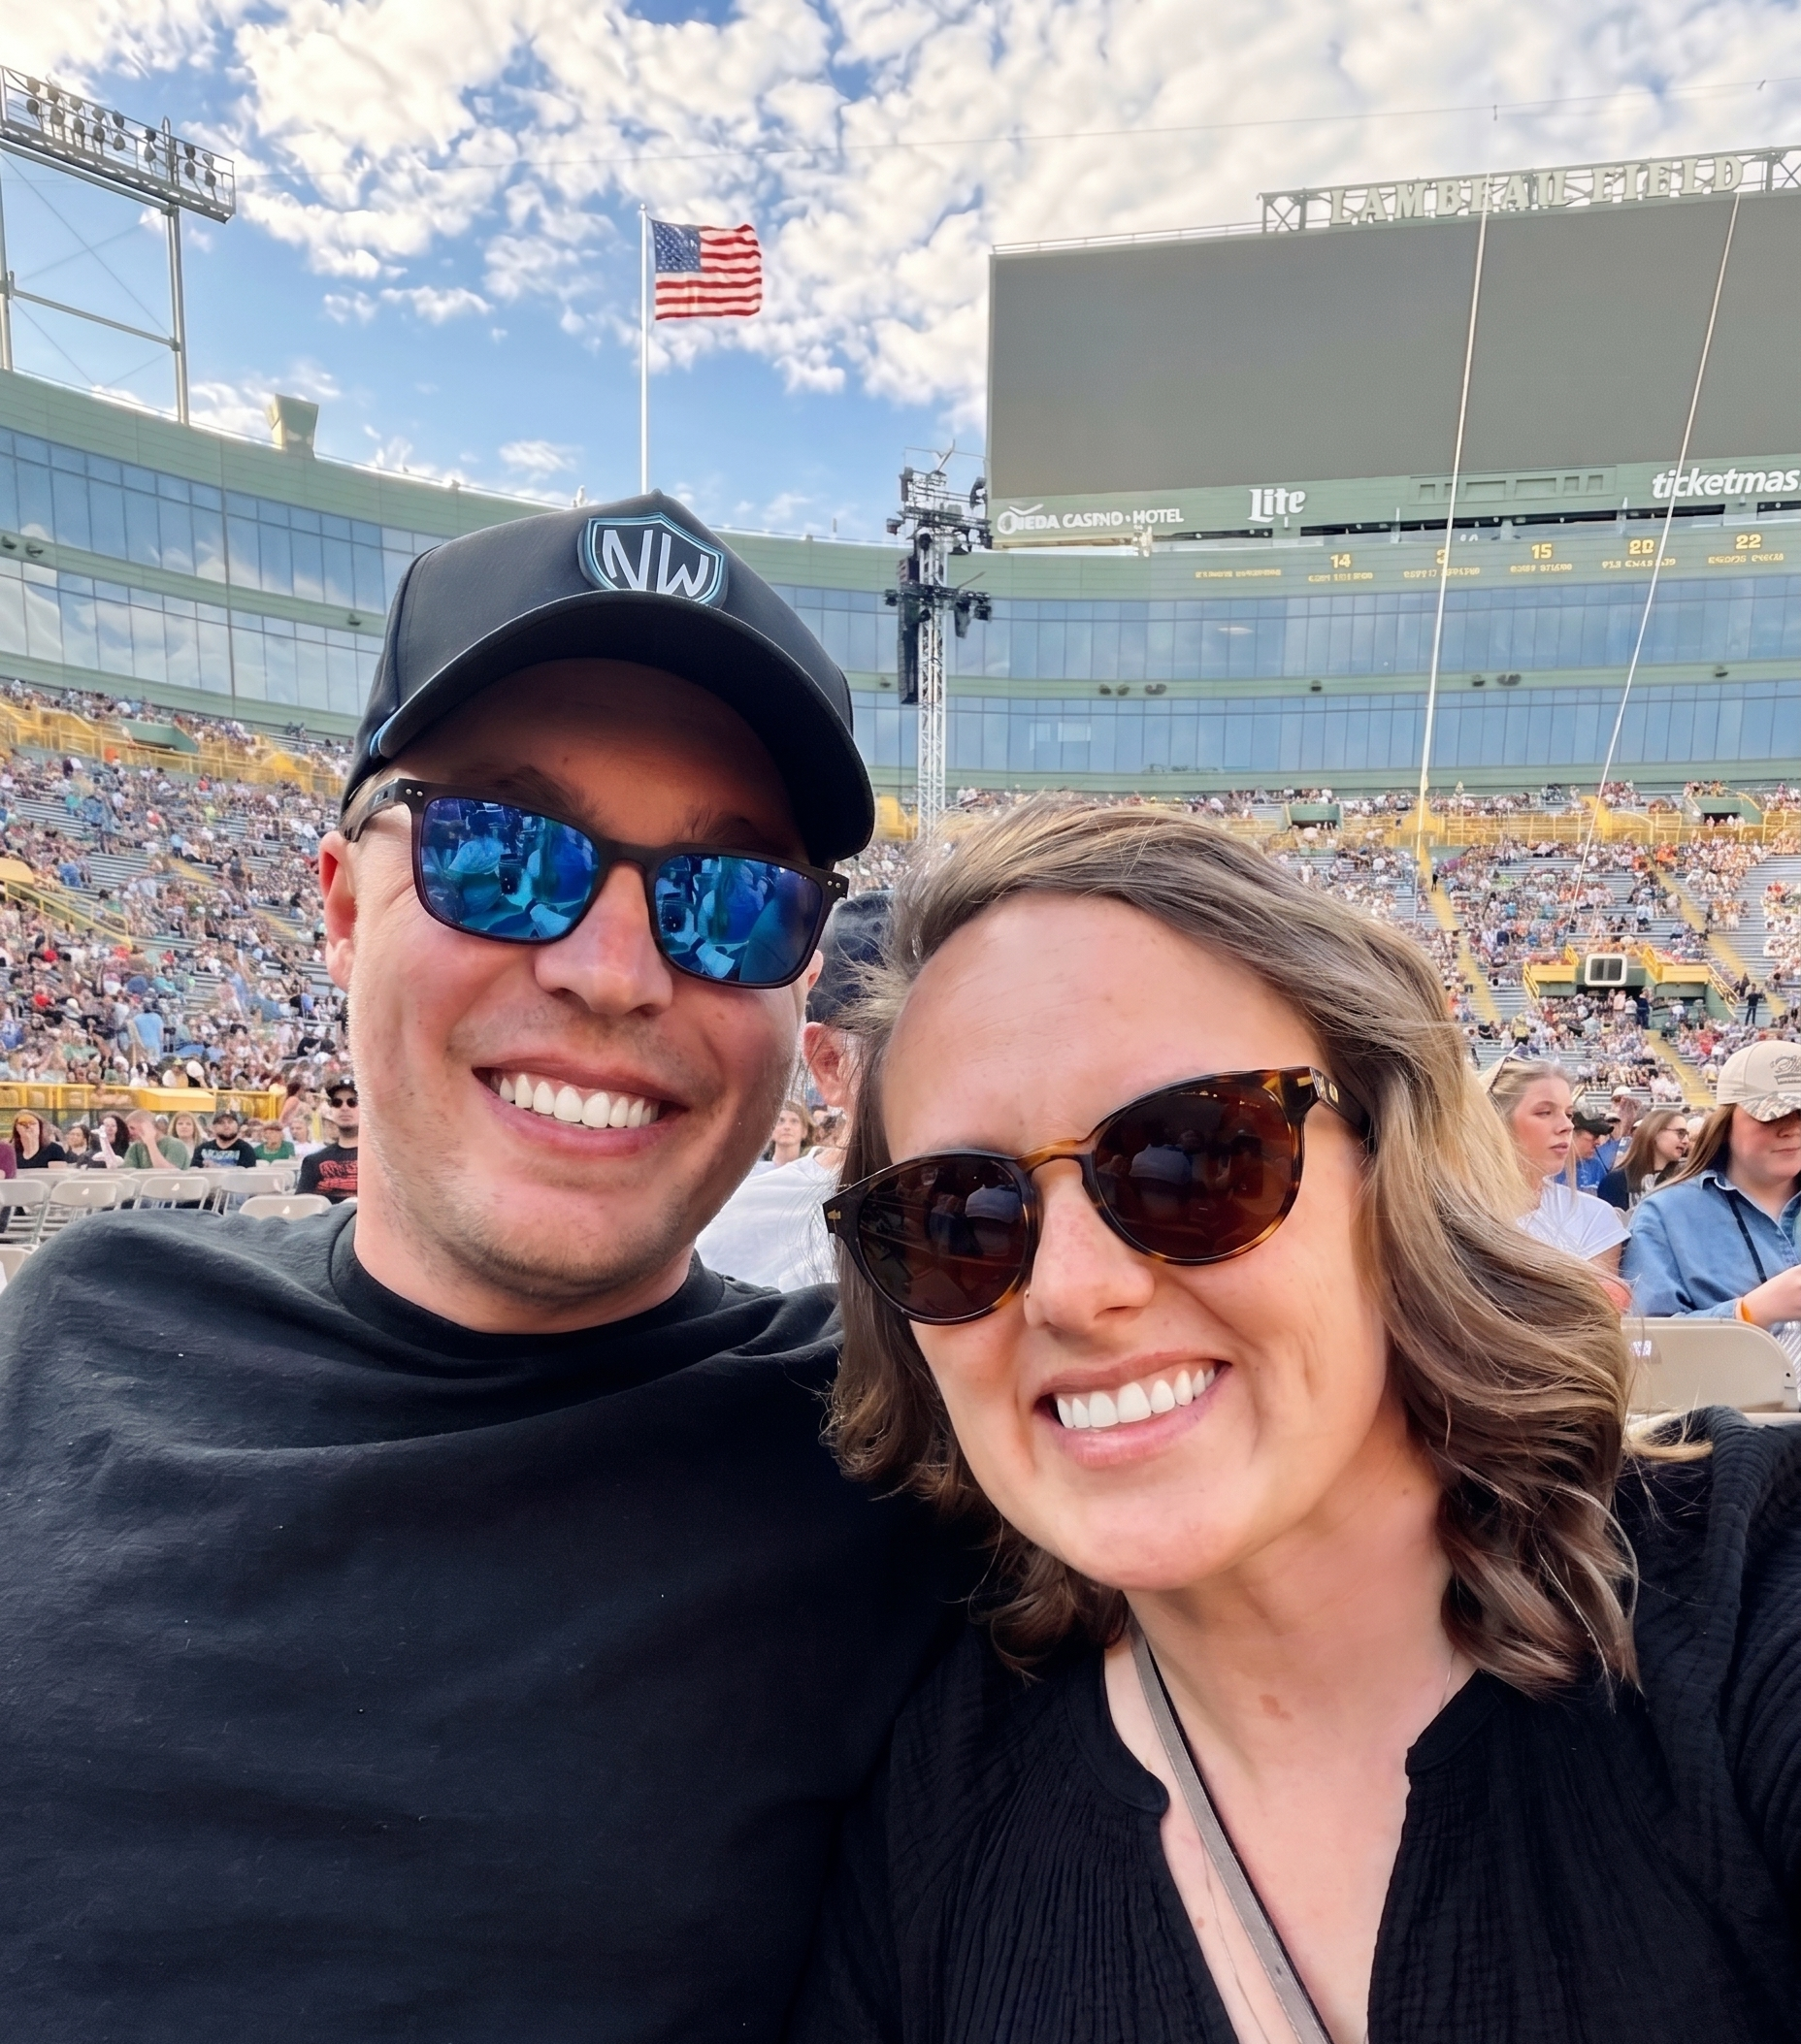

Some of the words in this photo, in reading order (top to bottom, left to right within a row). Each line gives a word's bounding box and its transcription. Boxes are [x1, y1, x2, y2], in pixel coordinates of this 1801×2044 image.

[1329, 170, 1569, 225] LAMBEAU
[1590, 155, 1744, 204] FIELD
[1652, 468, 1801, 500] ticketmas
[1132, 508, 1185, 525] HOTEL
[1246, 488, 1306, 523] Lite
[1531, 543, 1553, 560] 15
[1735, 534, 1762, 550] 22
[602, 529, 709, 598] NW
[1330, 553, 1352, 569] 14
